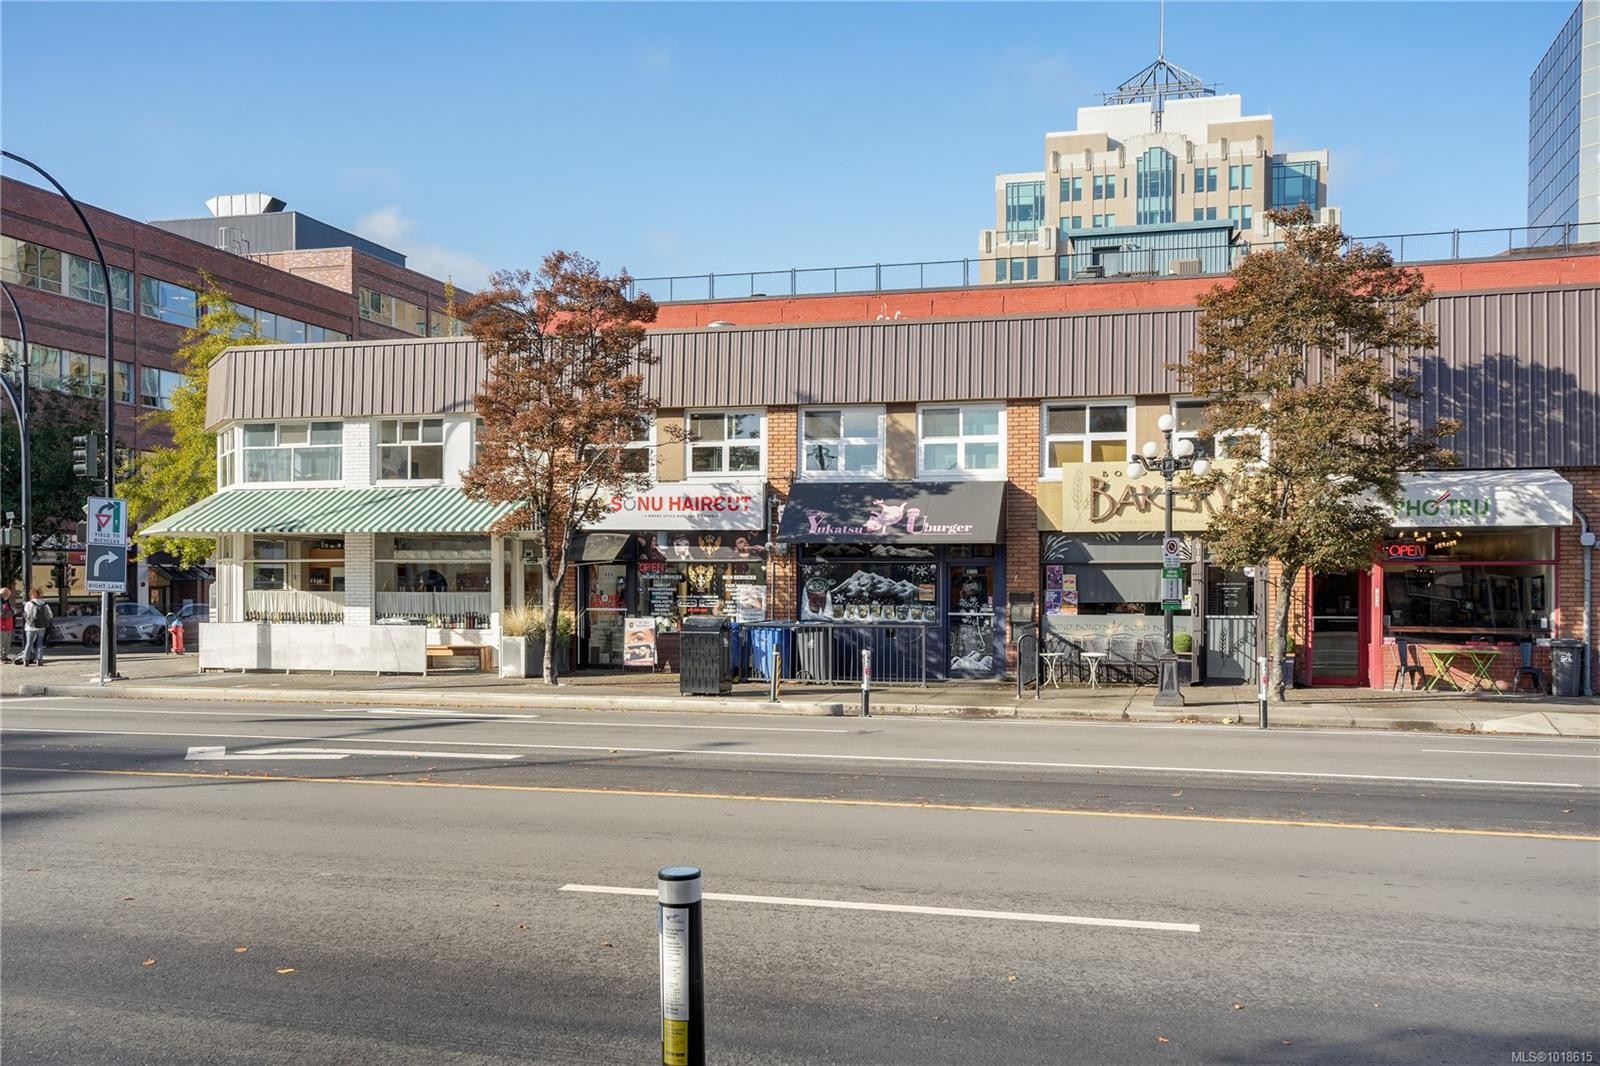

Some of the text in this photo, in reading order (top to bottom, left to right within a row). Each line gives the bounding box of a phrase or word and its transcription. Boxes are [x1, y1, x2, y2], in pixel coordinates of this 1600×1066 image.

[610, 496, 751, 512] SONU HAIRCUT
[805, 509, 864, 535] Yukatsu
[1389, 545, 1426, 556] OPEN
[639, 562, 665, 573] OPEN
